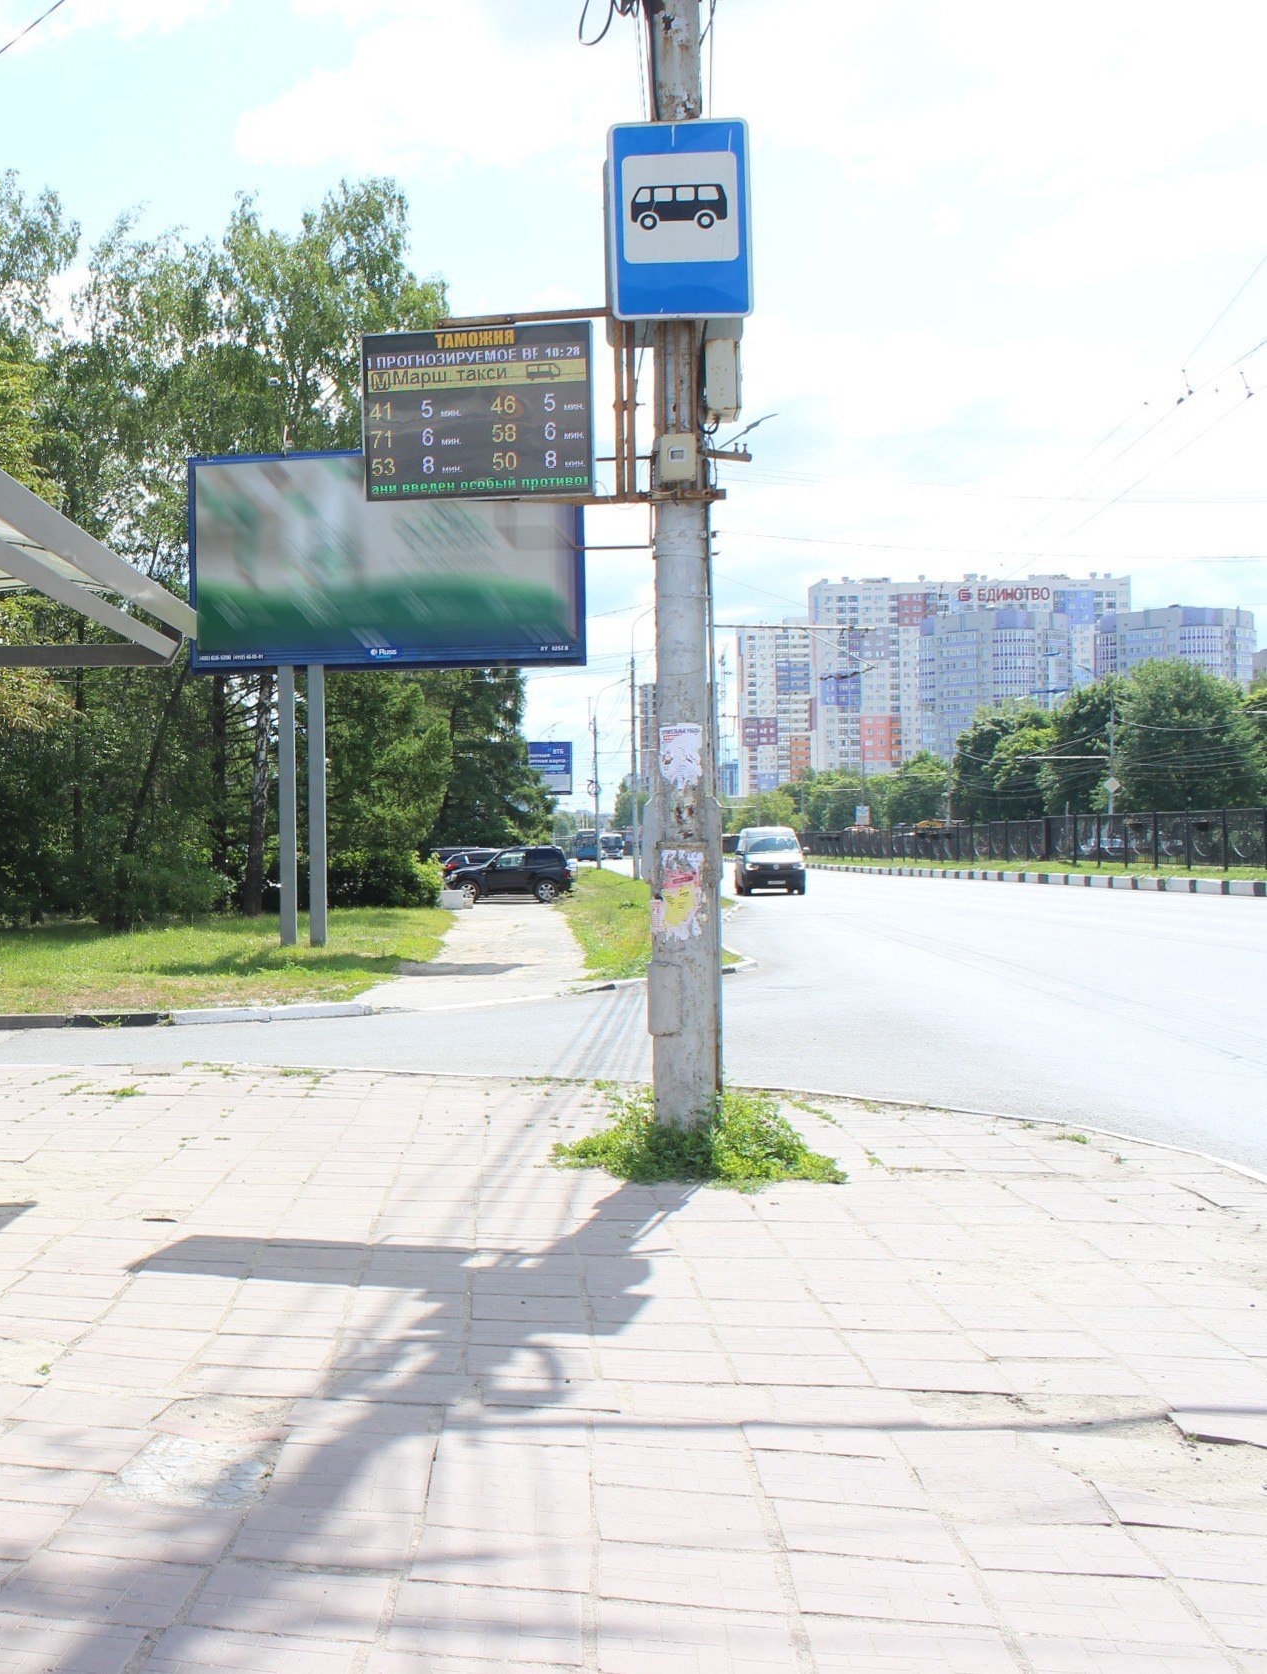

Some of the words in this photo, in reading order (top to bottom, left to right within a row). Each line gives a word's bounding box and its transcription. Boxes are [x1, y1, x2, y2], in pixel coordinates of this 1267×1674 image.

[434, 330, 515, 348] ТАМОЖНЯ
[377, 348, 517, 369] ПРОГНОЗИРУЕМОЕ
[456, 368, 507, 384] такси
[370, 402, 391, 420] 41
[421, 400, 433, 418] 5
[440, 409, 461, 417] мин.
[490, 395, 516, 414] 46
[544, 393, 556, 411] 5
[564, 402, 585, 411] мин.
[371, 430, 392, 449] 71
[422, 428, 433, 447] 6
[441, 437, 462, 446] мин.
[492, 424, 516, 443] 58
[544, 422, 556, 440] 6
[564, 431, 585, 440] мин.
[372, 458, 395, 477] 53
[423, 456, 434, 475] 8
[442, 465, 463, 473] мин.
[493, 452, 517, 471] 50
[544, 450, 557, 469] 8
[564, 459, 586, 468] мин.
[402, 482, 455, 494] введен
[460, 476, 516, 490] особый
